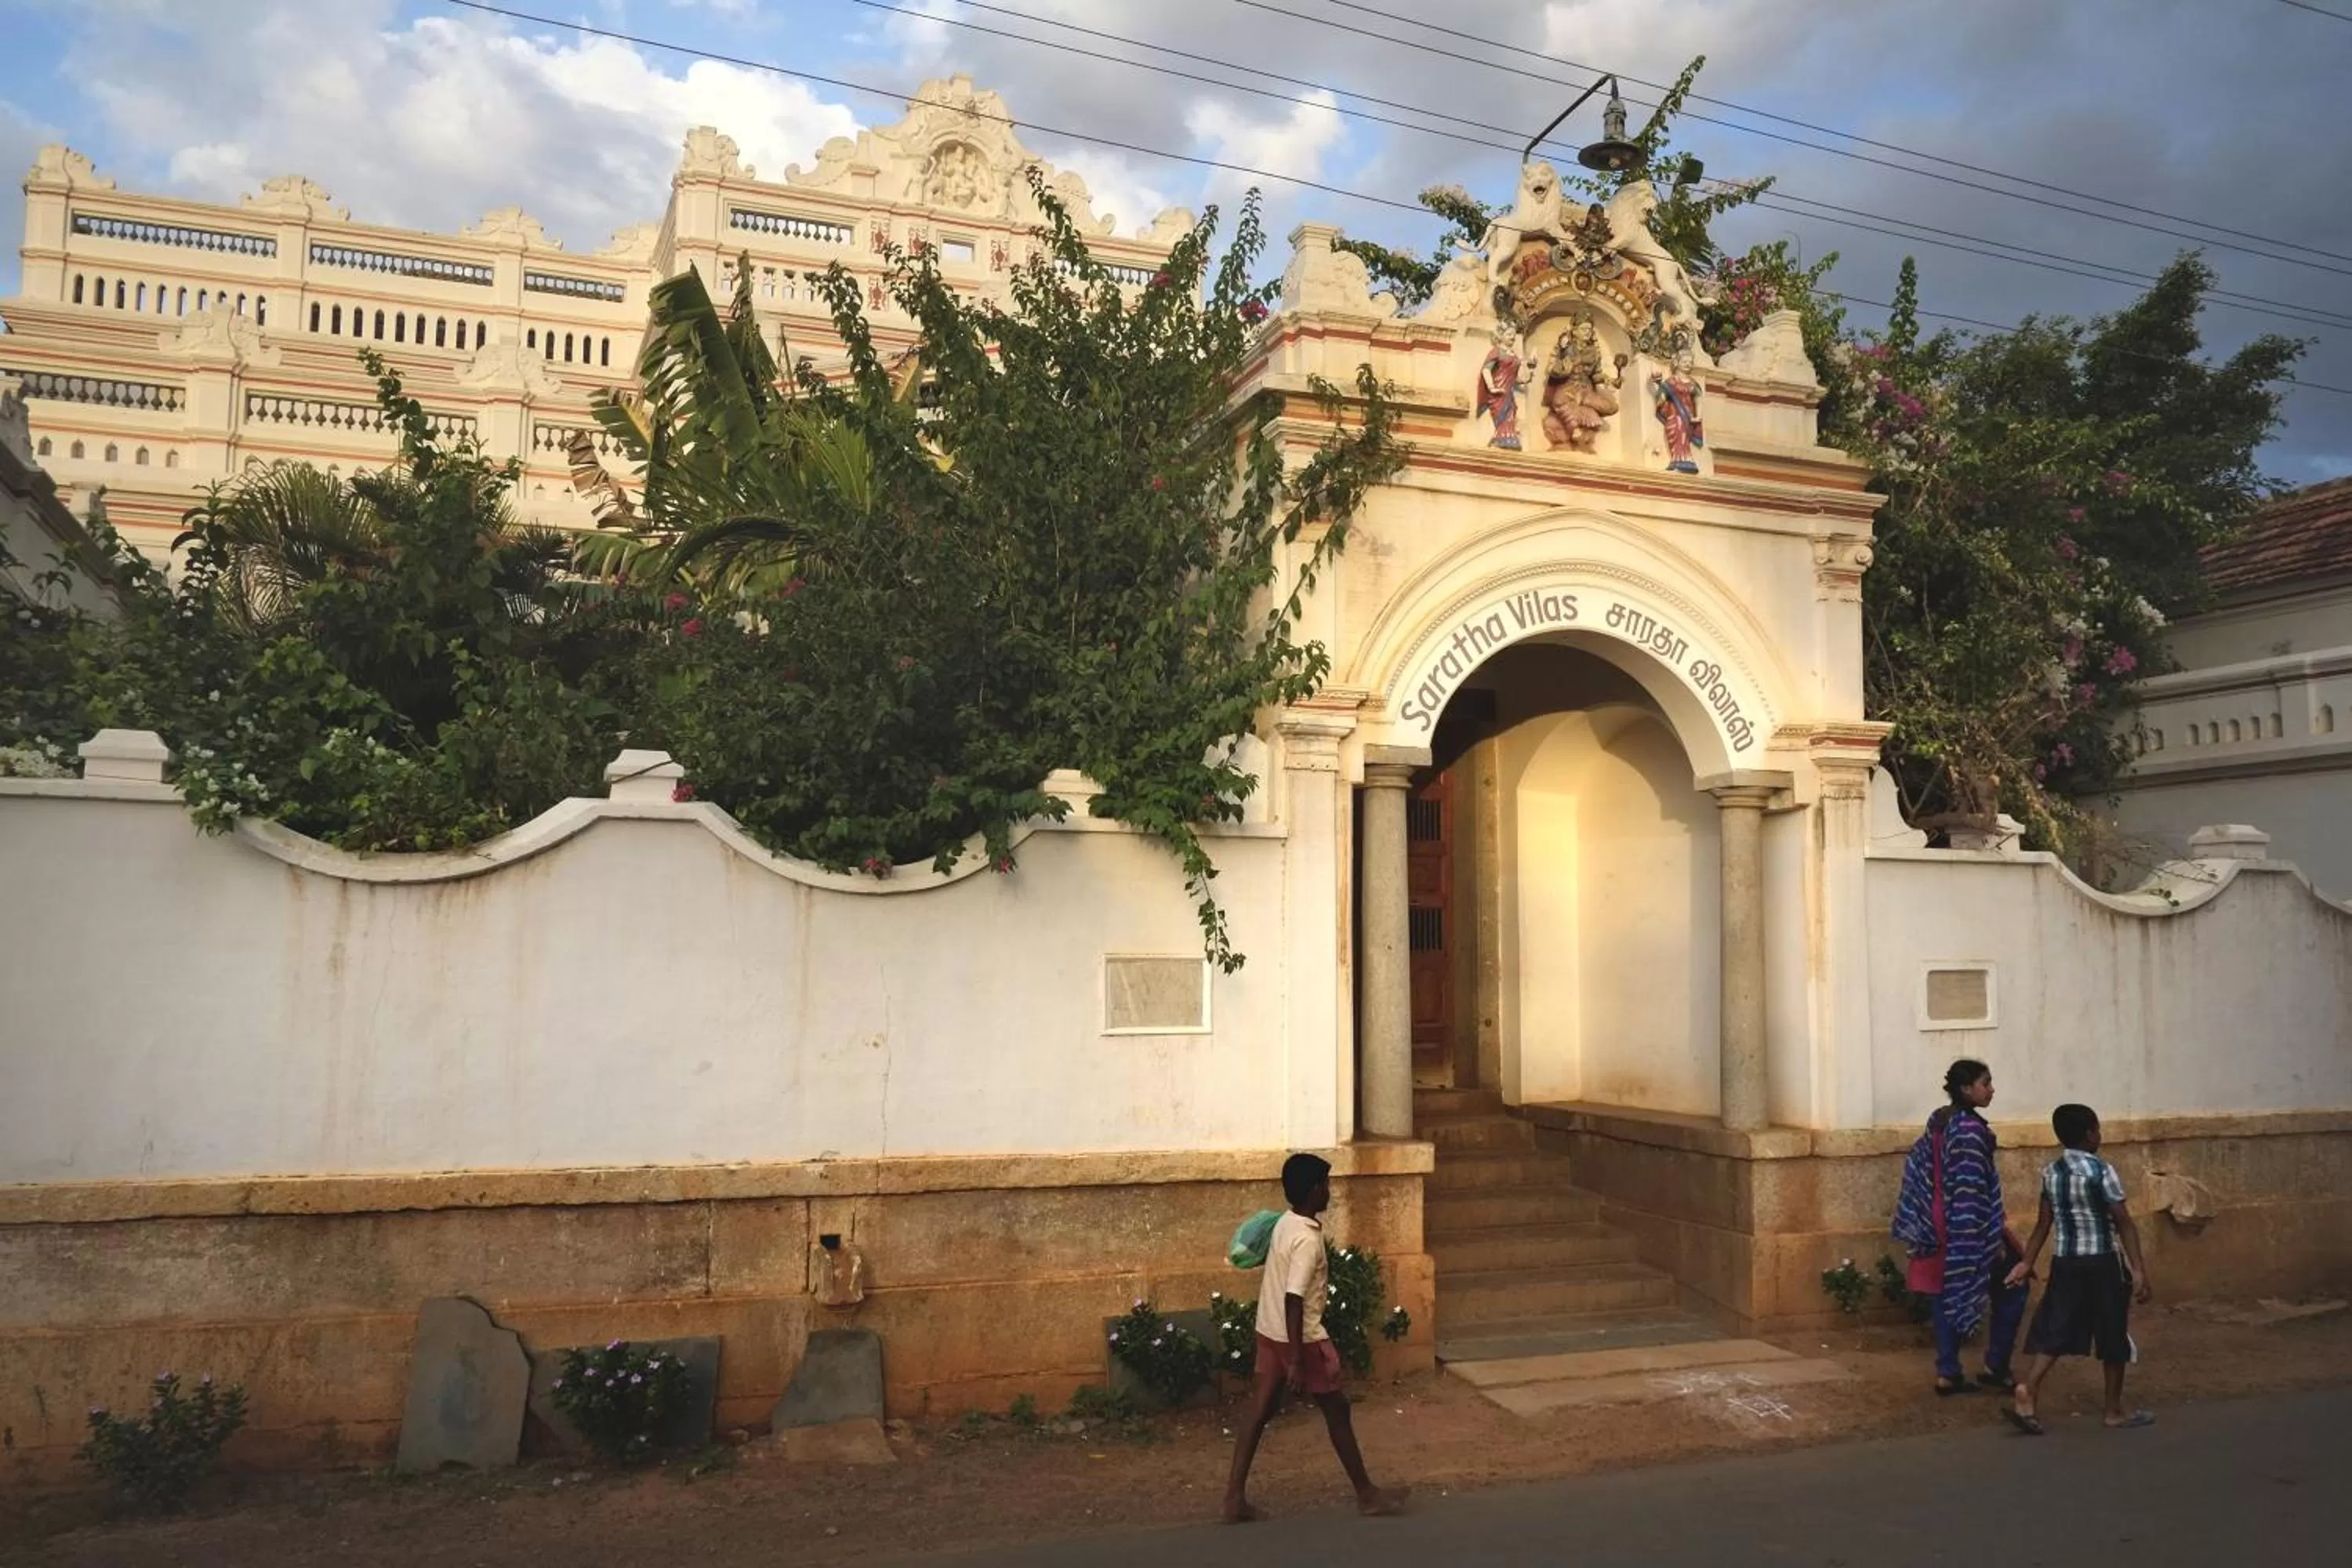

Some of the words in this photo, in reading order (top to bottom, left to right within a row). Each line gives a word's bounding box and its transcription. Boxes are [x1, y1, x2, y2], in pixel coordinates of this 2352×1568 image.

[1401, 612, 1508, 731] Saratha
[1506, 590, 1578, 630] Vilas
[1606, 602, 1689, 665] சாரதா
[1690, 659, 1754, 753] விலாஸ்
